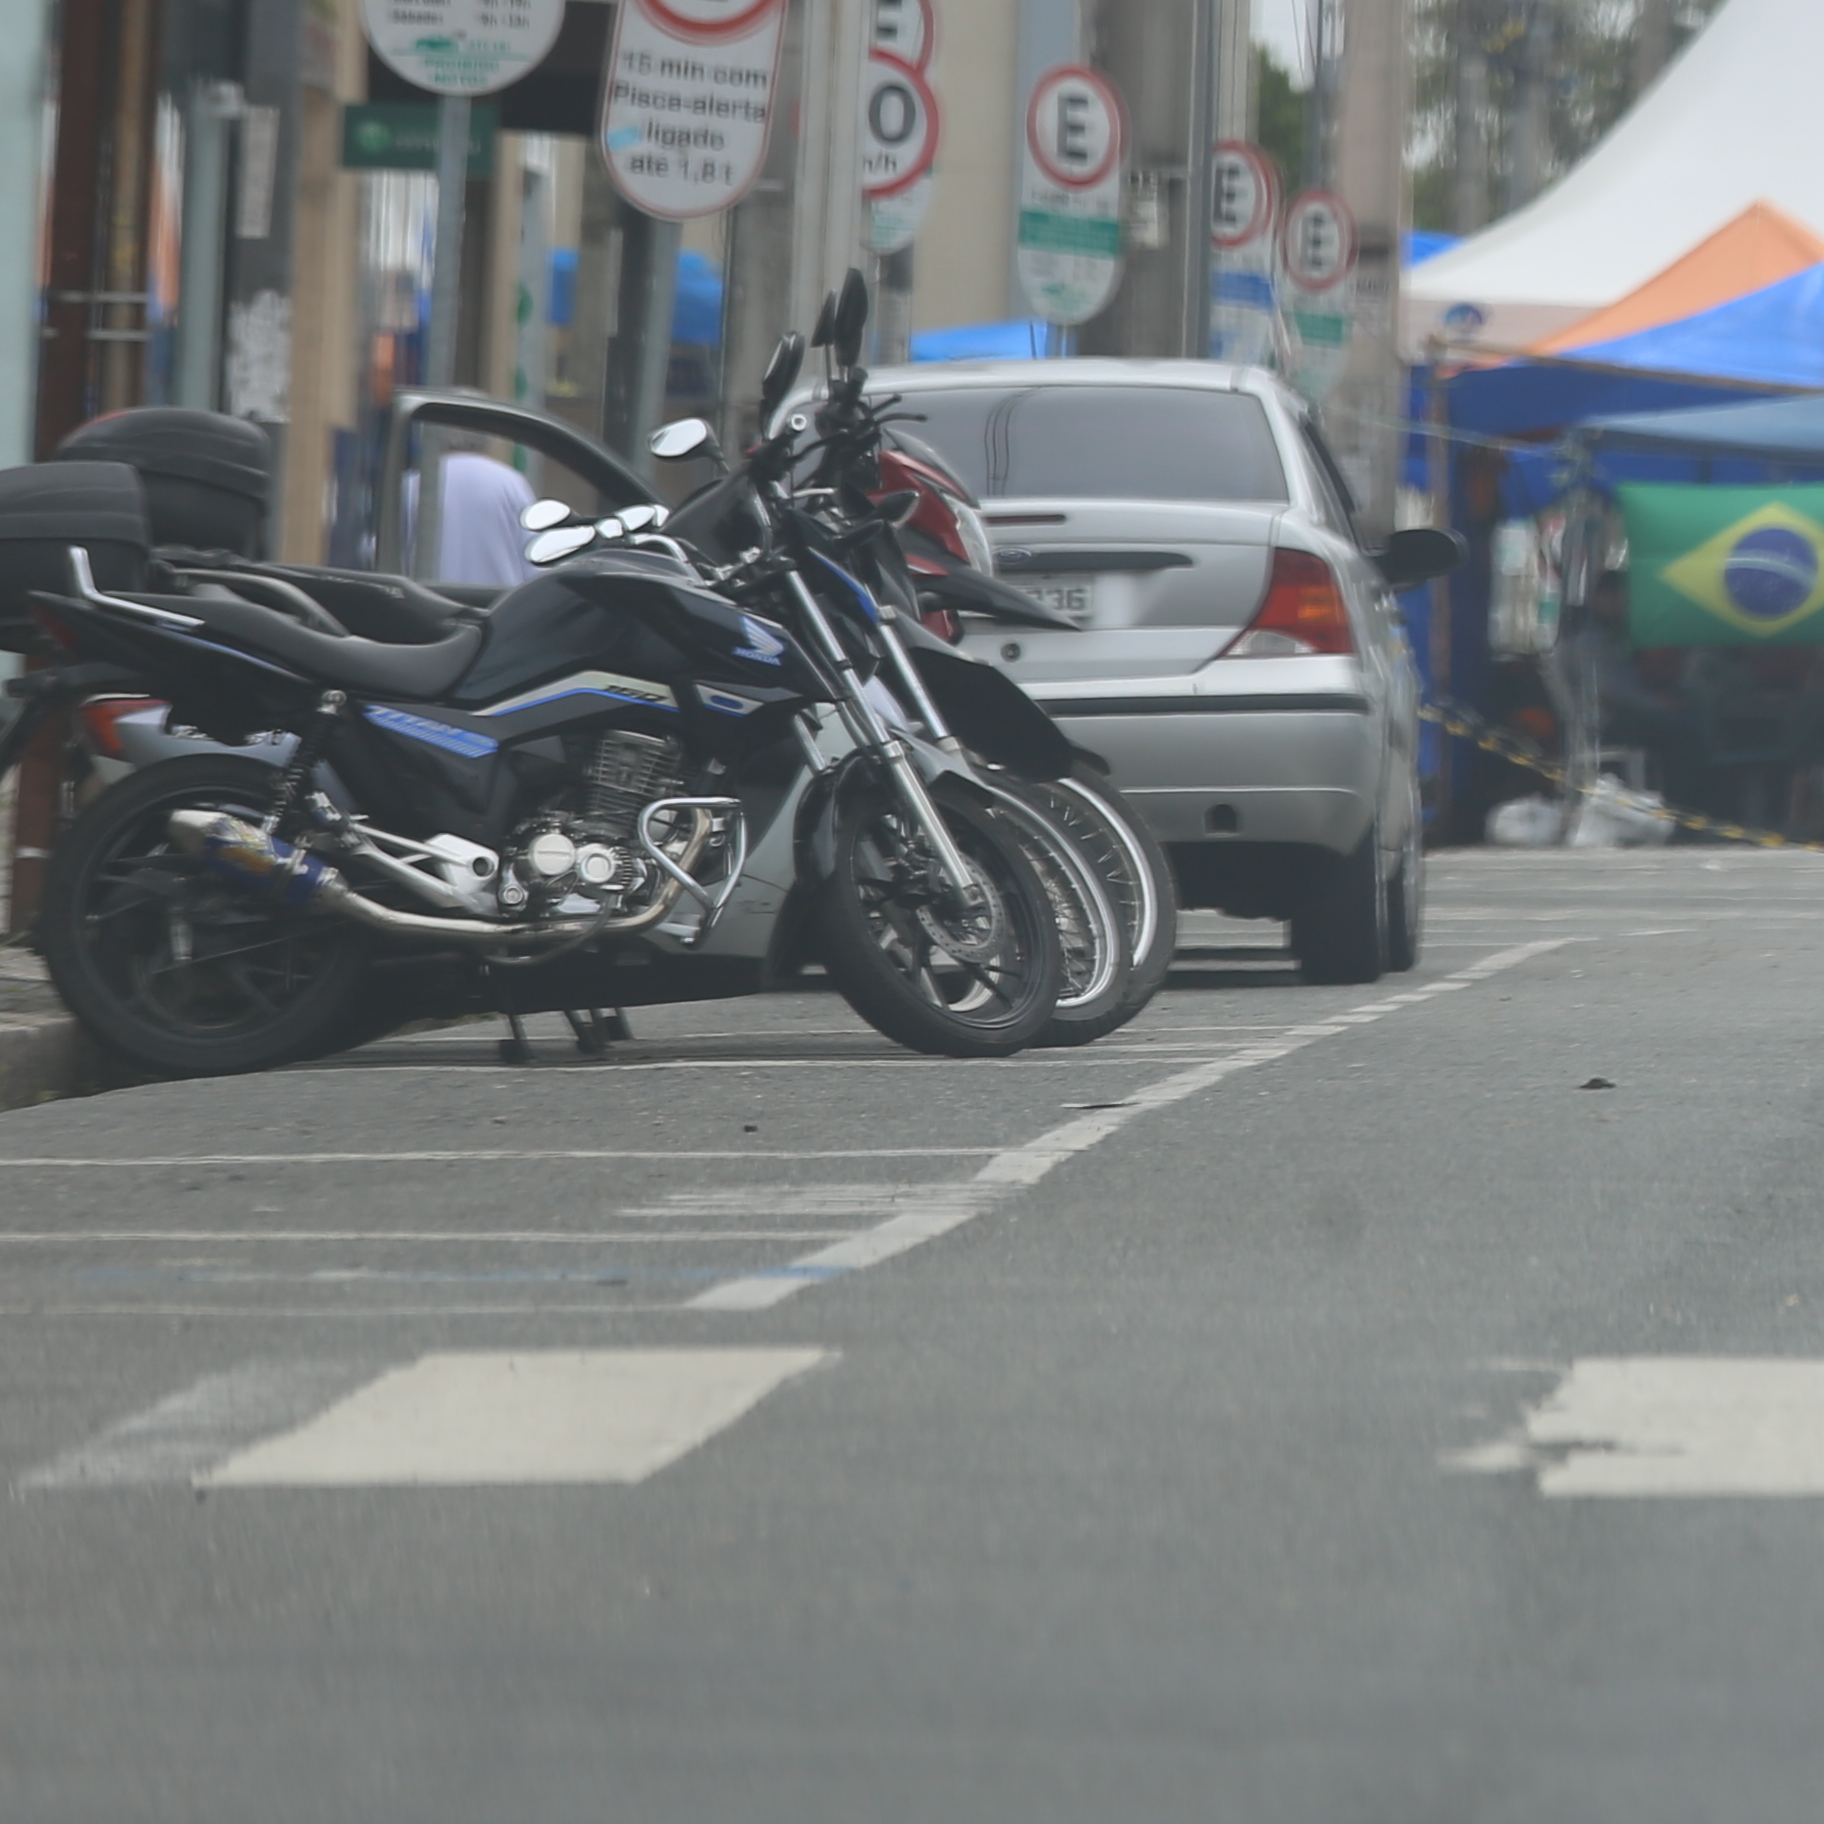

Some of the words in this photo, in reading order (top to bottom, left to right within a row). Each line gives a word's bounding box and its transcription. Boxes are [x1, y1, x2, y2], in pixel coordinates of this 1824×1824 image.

[660, 55, 704, 78] min
[712, 63, 768, 90] com
[645, 117, 725, 152] ligado
[1056, 93, 1089, 165] E
[733, 646, 783, 666] HONDA
